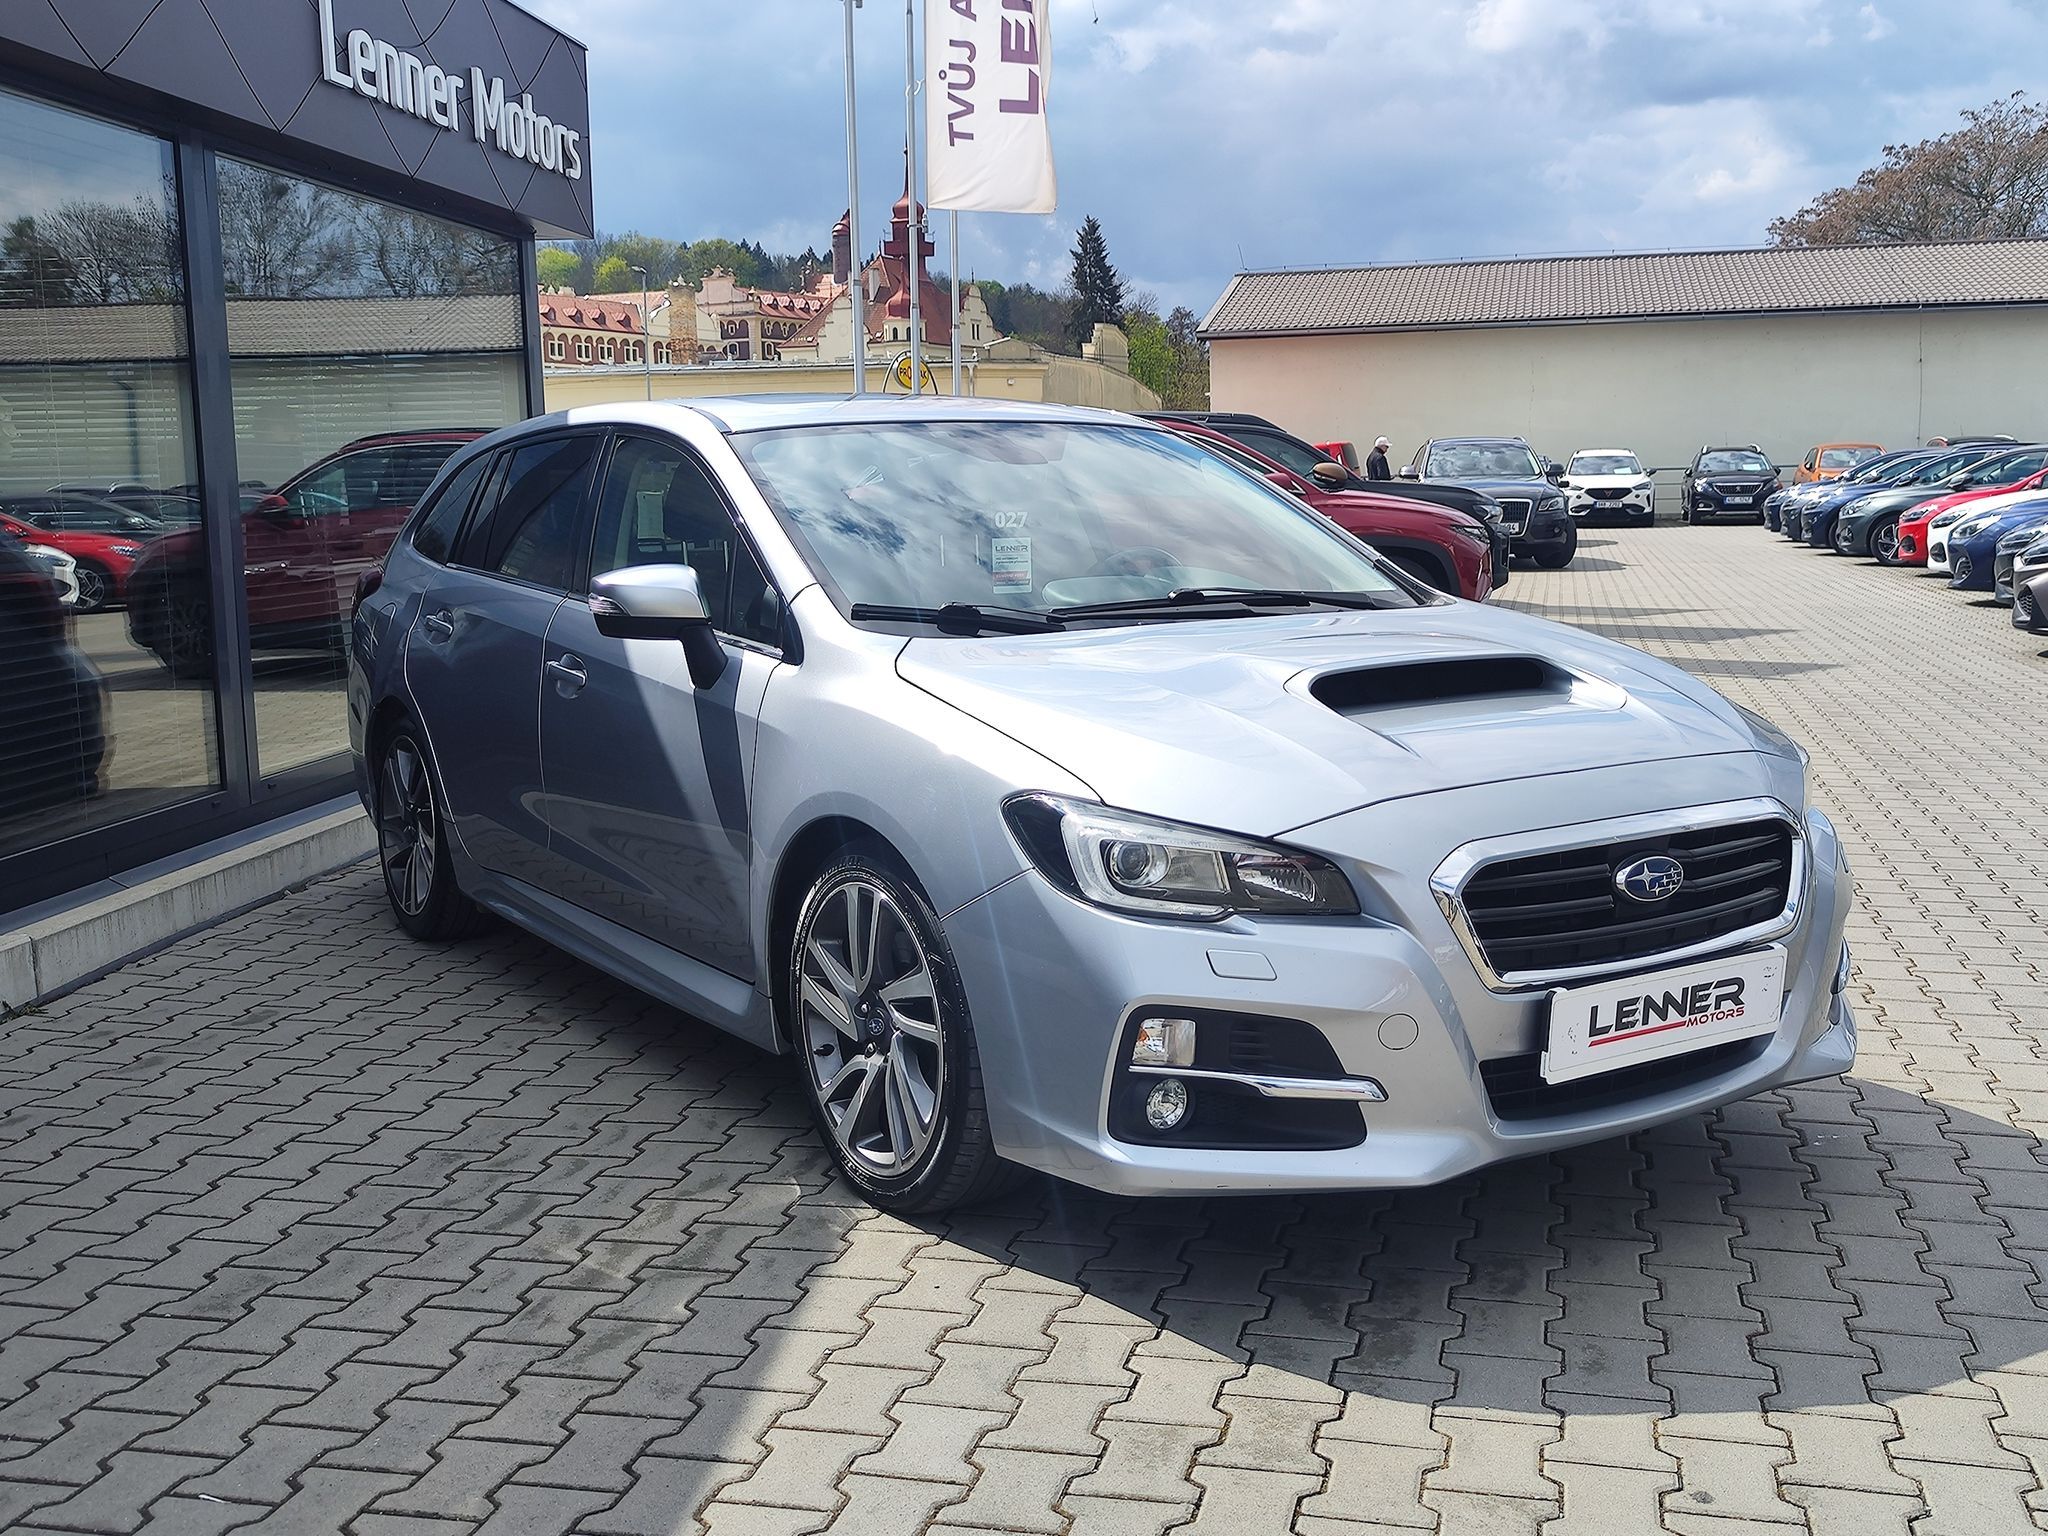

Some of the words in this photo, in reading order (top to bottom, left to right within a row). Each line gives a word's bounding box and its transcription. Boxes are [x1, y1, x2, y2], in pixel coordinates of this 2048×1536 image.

[318, 0, 464, 132] Lenner
[470, 65, 583, 180] Motors
[938, 39, 977, 147] TVŮJ
[994, 511, 1028, 528] 027
[1588, 976, 1746, 1038] LENNER
[1686, 1005, 1746, 1028] MOTORS
